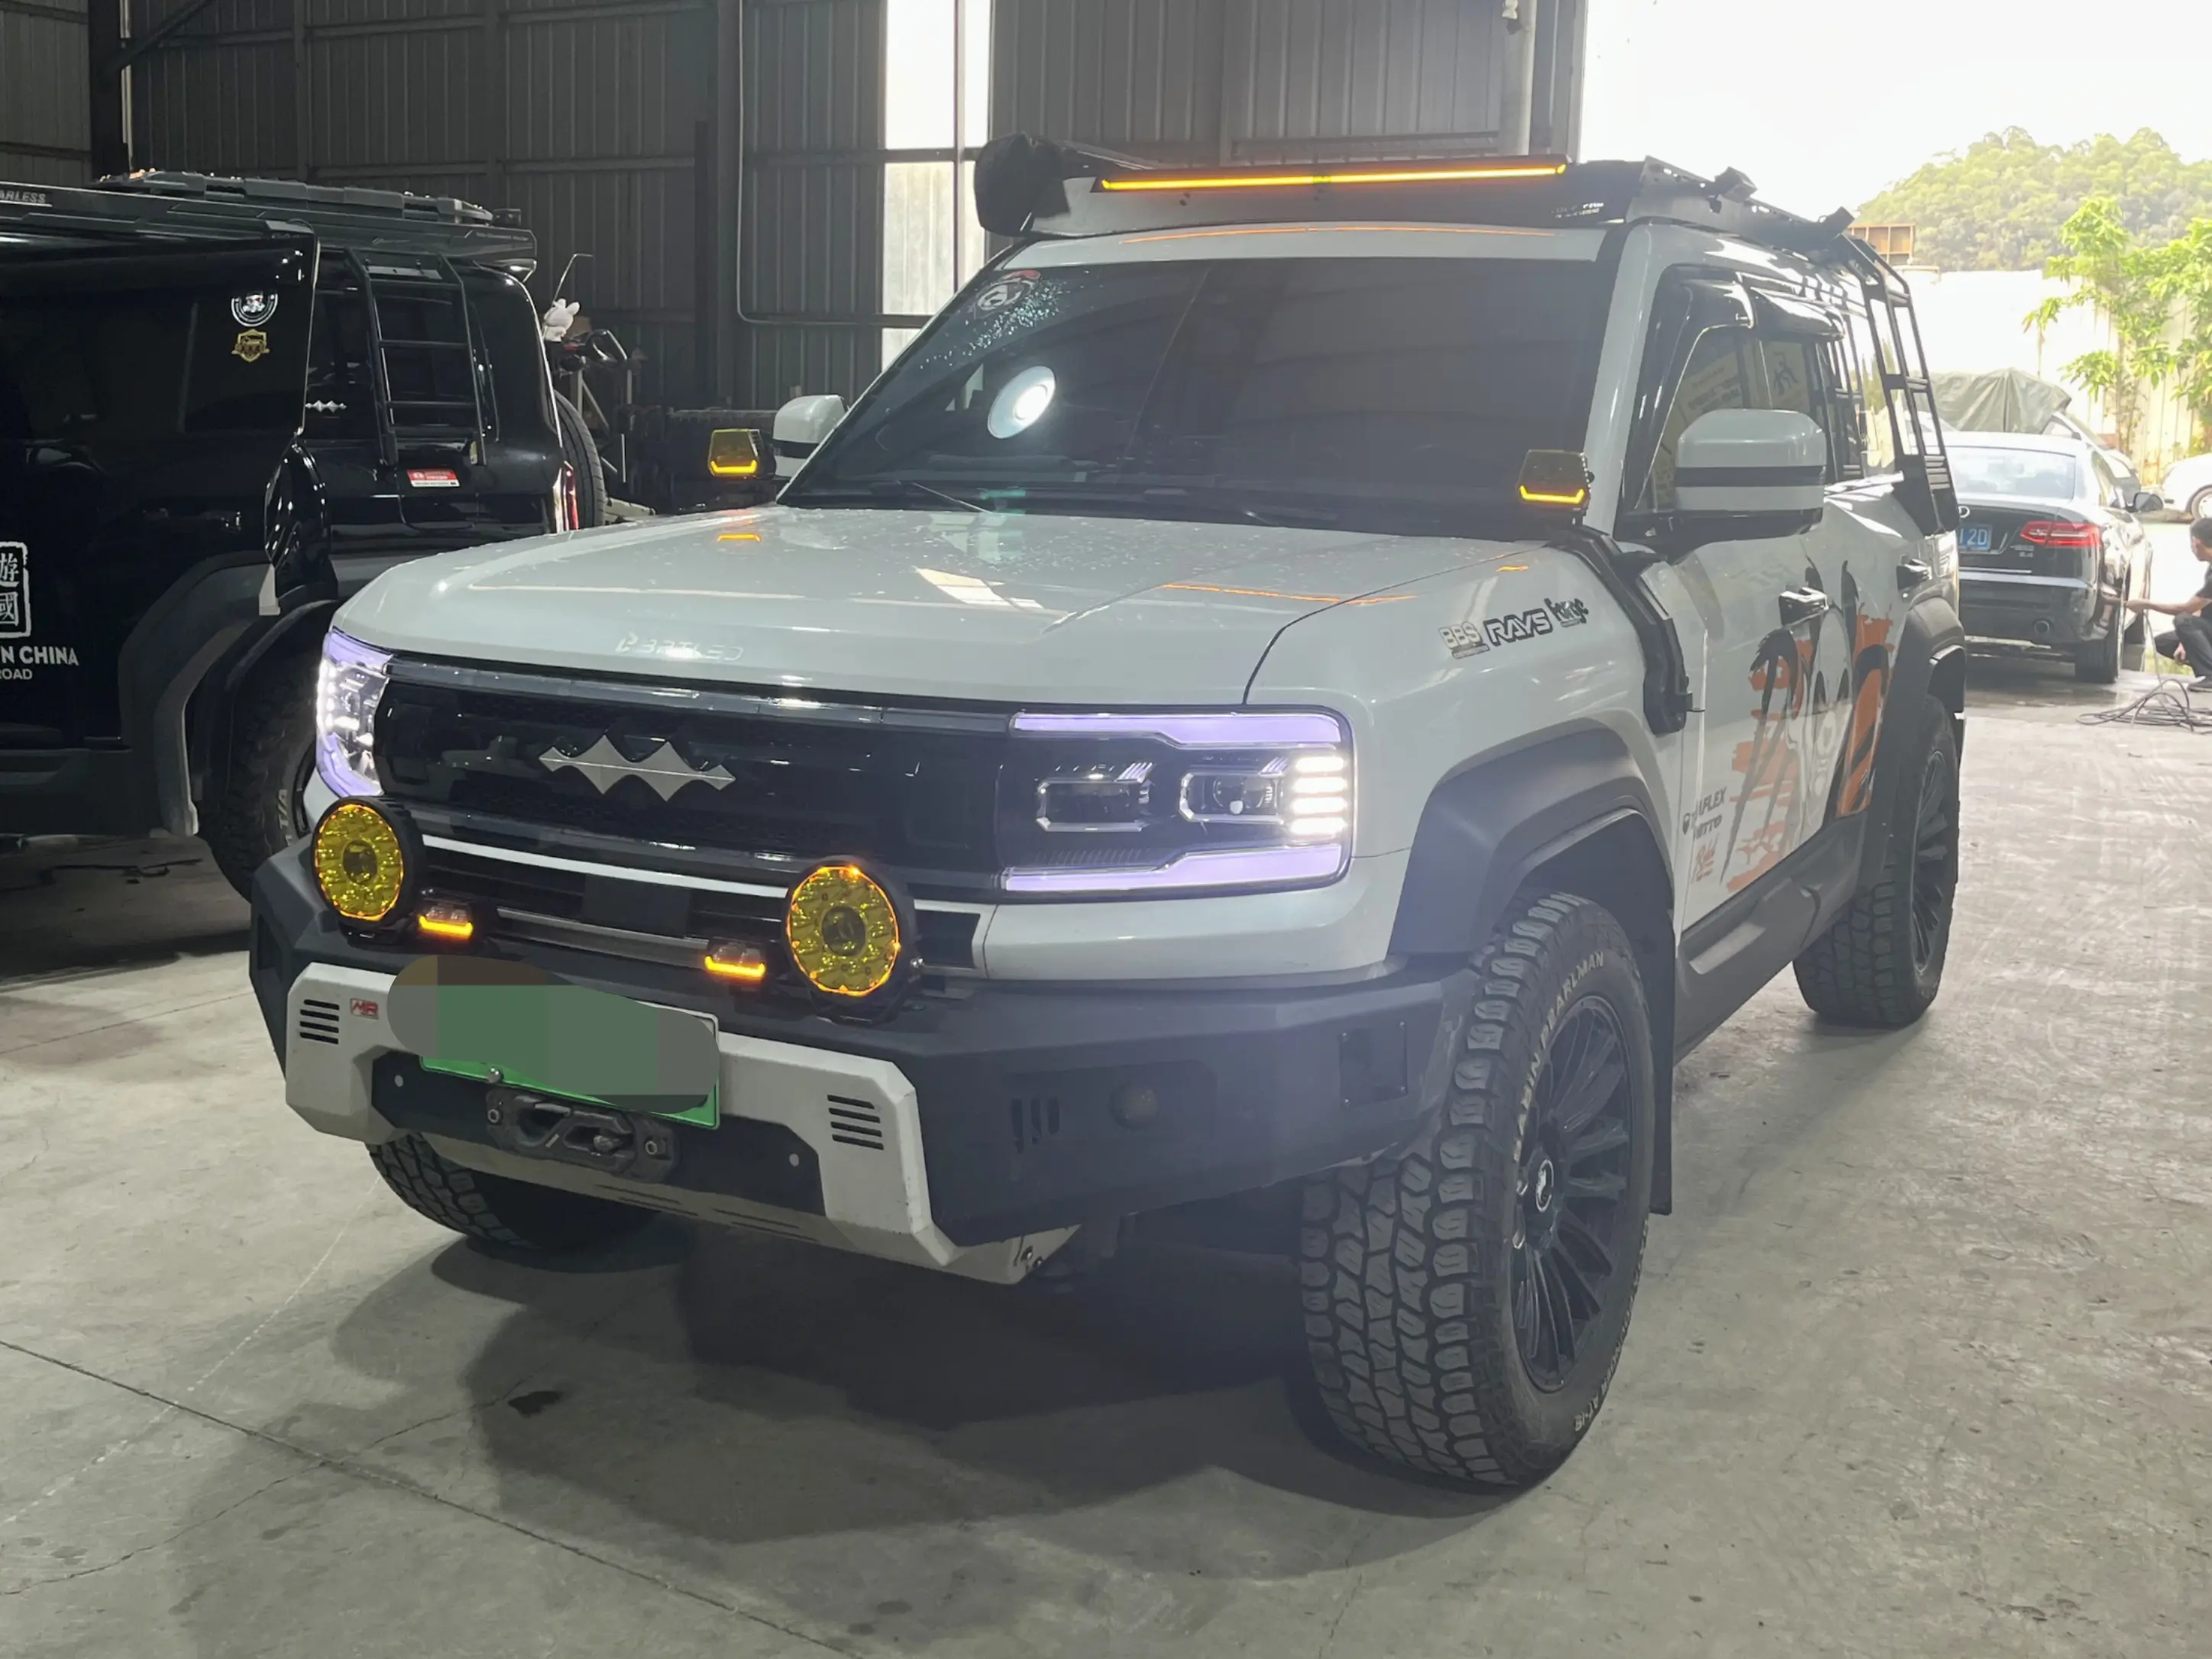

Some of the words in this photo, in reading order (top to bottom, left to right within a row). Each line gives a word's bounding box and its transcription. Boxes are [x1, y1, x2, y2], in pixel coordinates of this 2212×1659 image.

[1438, 621, 1483, 649] BBS
[1483, 608, 1554, 646] RAYS
[19, 646, 79, 666] CHINA
